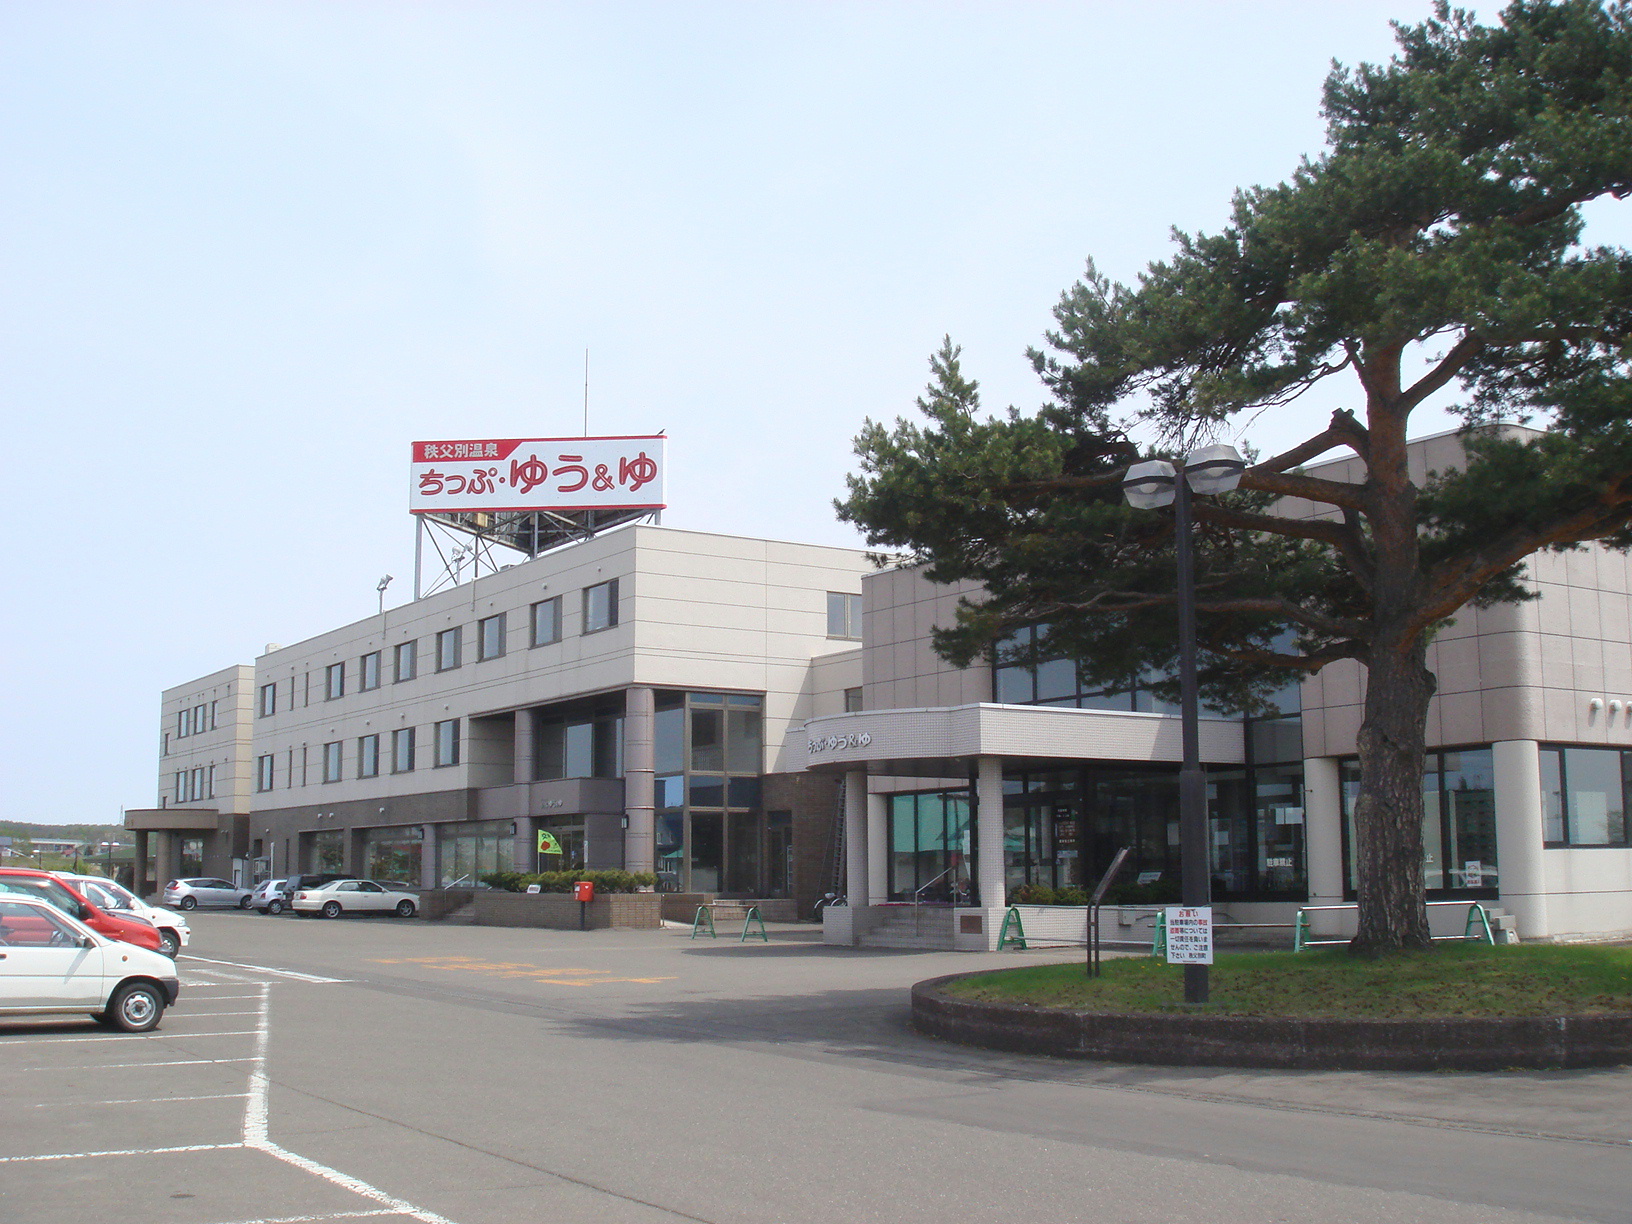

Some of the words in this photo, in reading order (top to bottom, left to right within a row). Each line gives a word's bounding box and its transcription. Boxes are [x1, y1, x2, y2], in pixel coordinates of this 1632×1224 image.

[424, 442, 498, 459] 秩父別温泉
